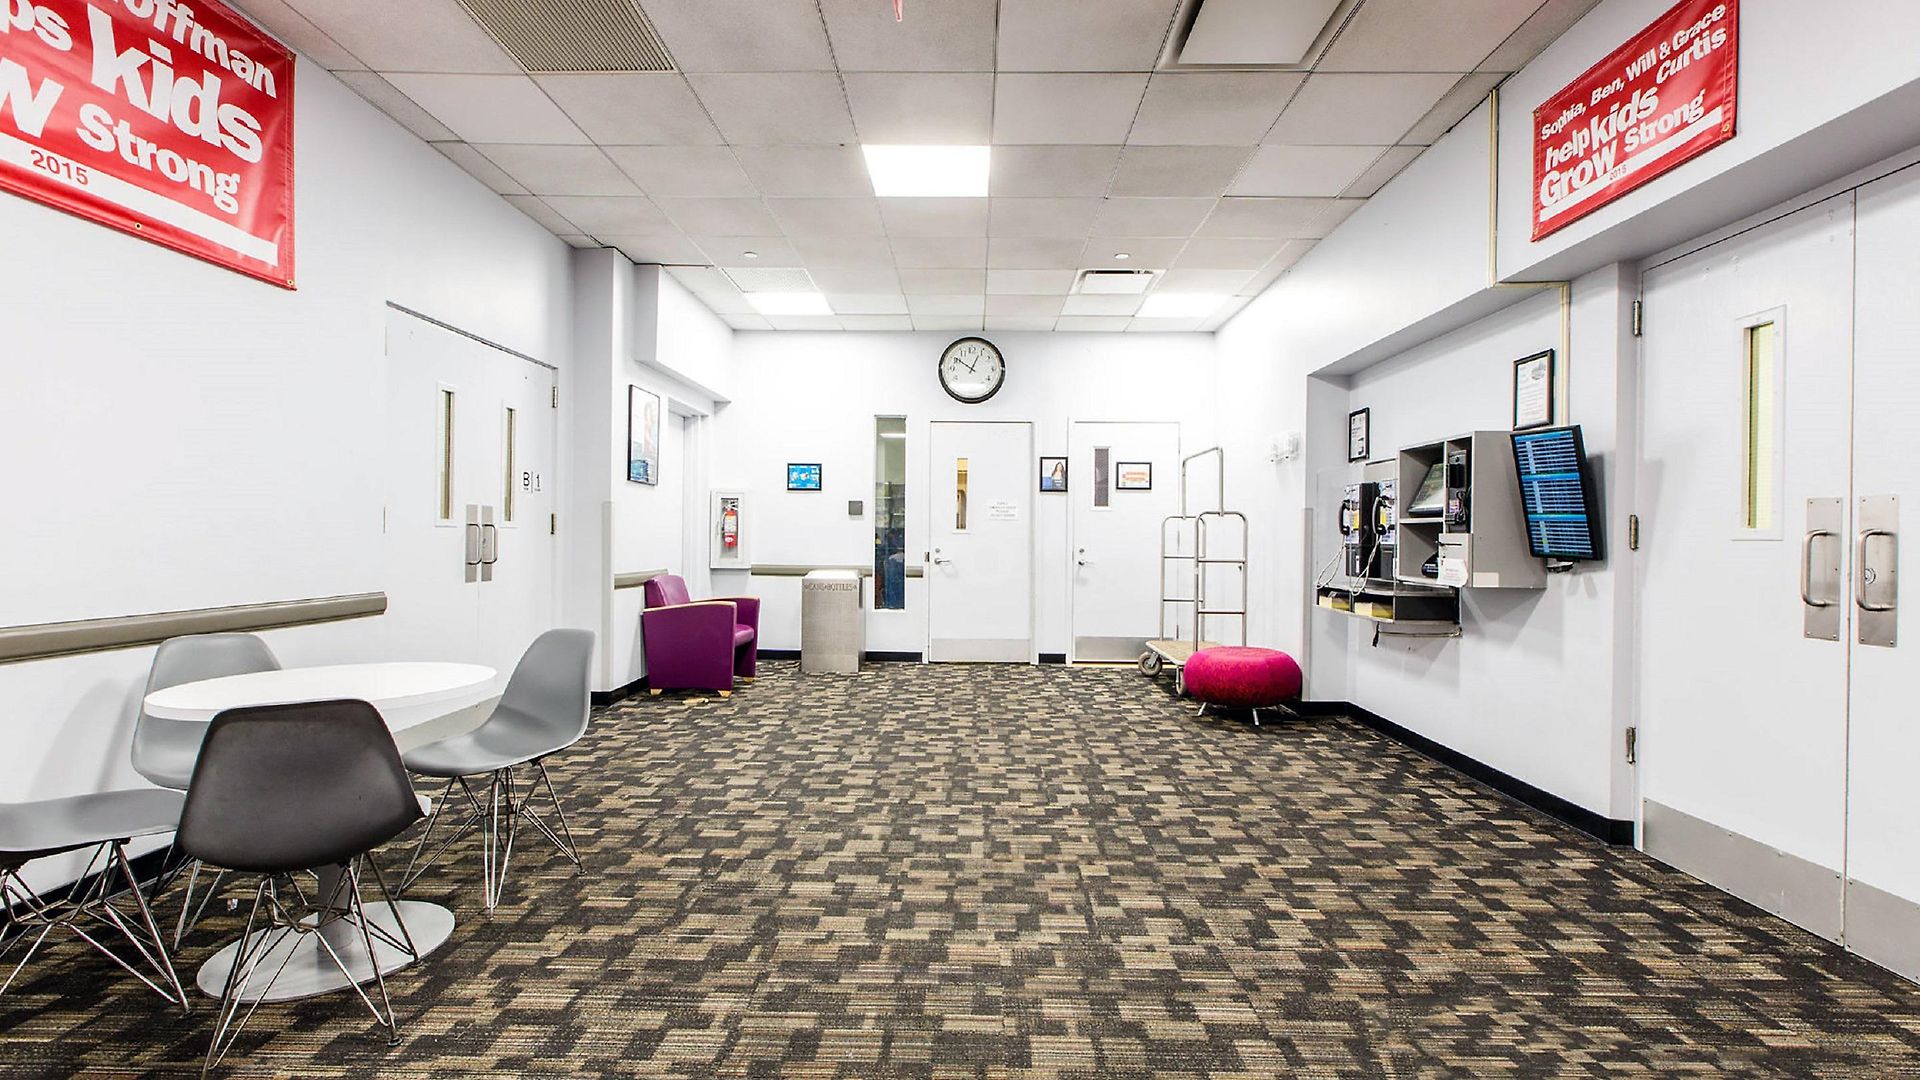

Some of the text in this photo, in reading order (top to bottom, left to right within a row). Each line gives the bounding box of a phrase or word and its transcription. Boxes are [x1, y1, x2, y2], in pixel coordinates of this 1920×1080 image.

[87, 2, 264, 164] kids
[114, 0, 277, 99] offman
[1541, 4, 1726, 140] Sophia, Ben, Will & Grace
[1656, 27, 1727, 84] Curtis
[1545, 87, 1659, 172] help kids
[1624, 89, 1706, 152] Strong
[30, 149, 89, 187] 2015
[76, 103, 240, 215] Strong
[1609, 164, 1627, 181] 2015
[523, 472, 530, 486] B
